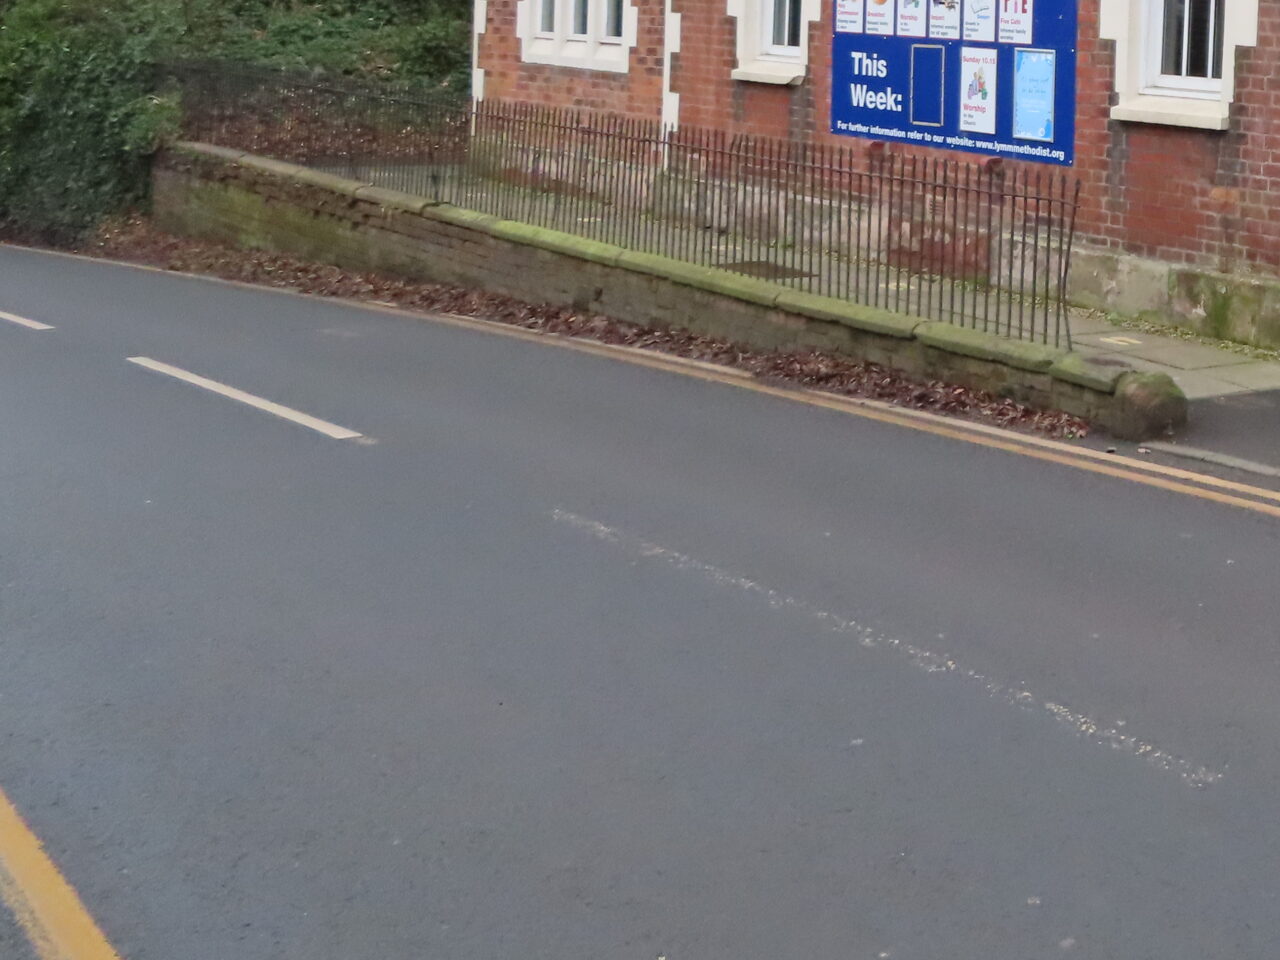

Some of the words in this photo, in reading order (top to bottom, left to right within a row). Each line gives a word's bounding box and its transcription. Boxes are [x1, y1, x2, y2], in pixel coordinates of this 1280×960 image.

[851, 51, 888, 78] This
[963, 55, 981, 65] Sunday
[850, 83, 903, 112] Week:
[963, 103, 987, 113] Worship
[837, 120, 848, 130] For
[848, 122, 870, 133] further
[869, 125, 906, 138] information
[907, 131, 924, 140] refer
[924, 132, 932, 142] to
[932, 135, 945, 143] our
[946, 136, 975, 147] website:
[975, 140, 1065, 161] www.lymmmethodist.org
